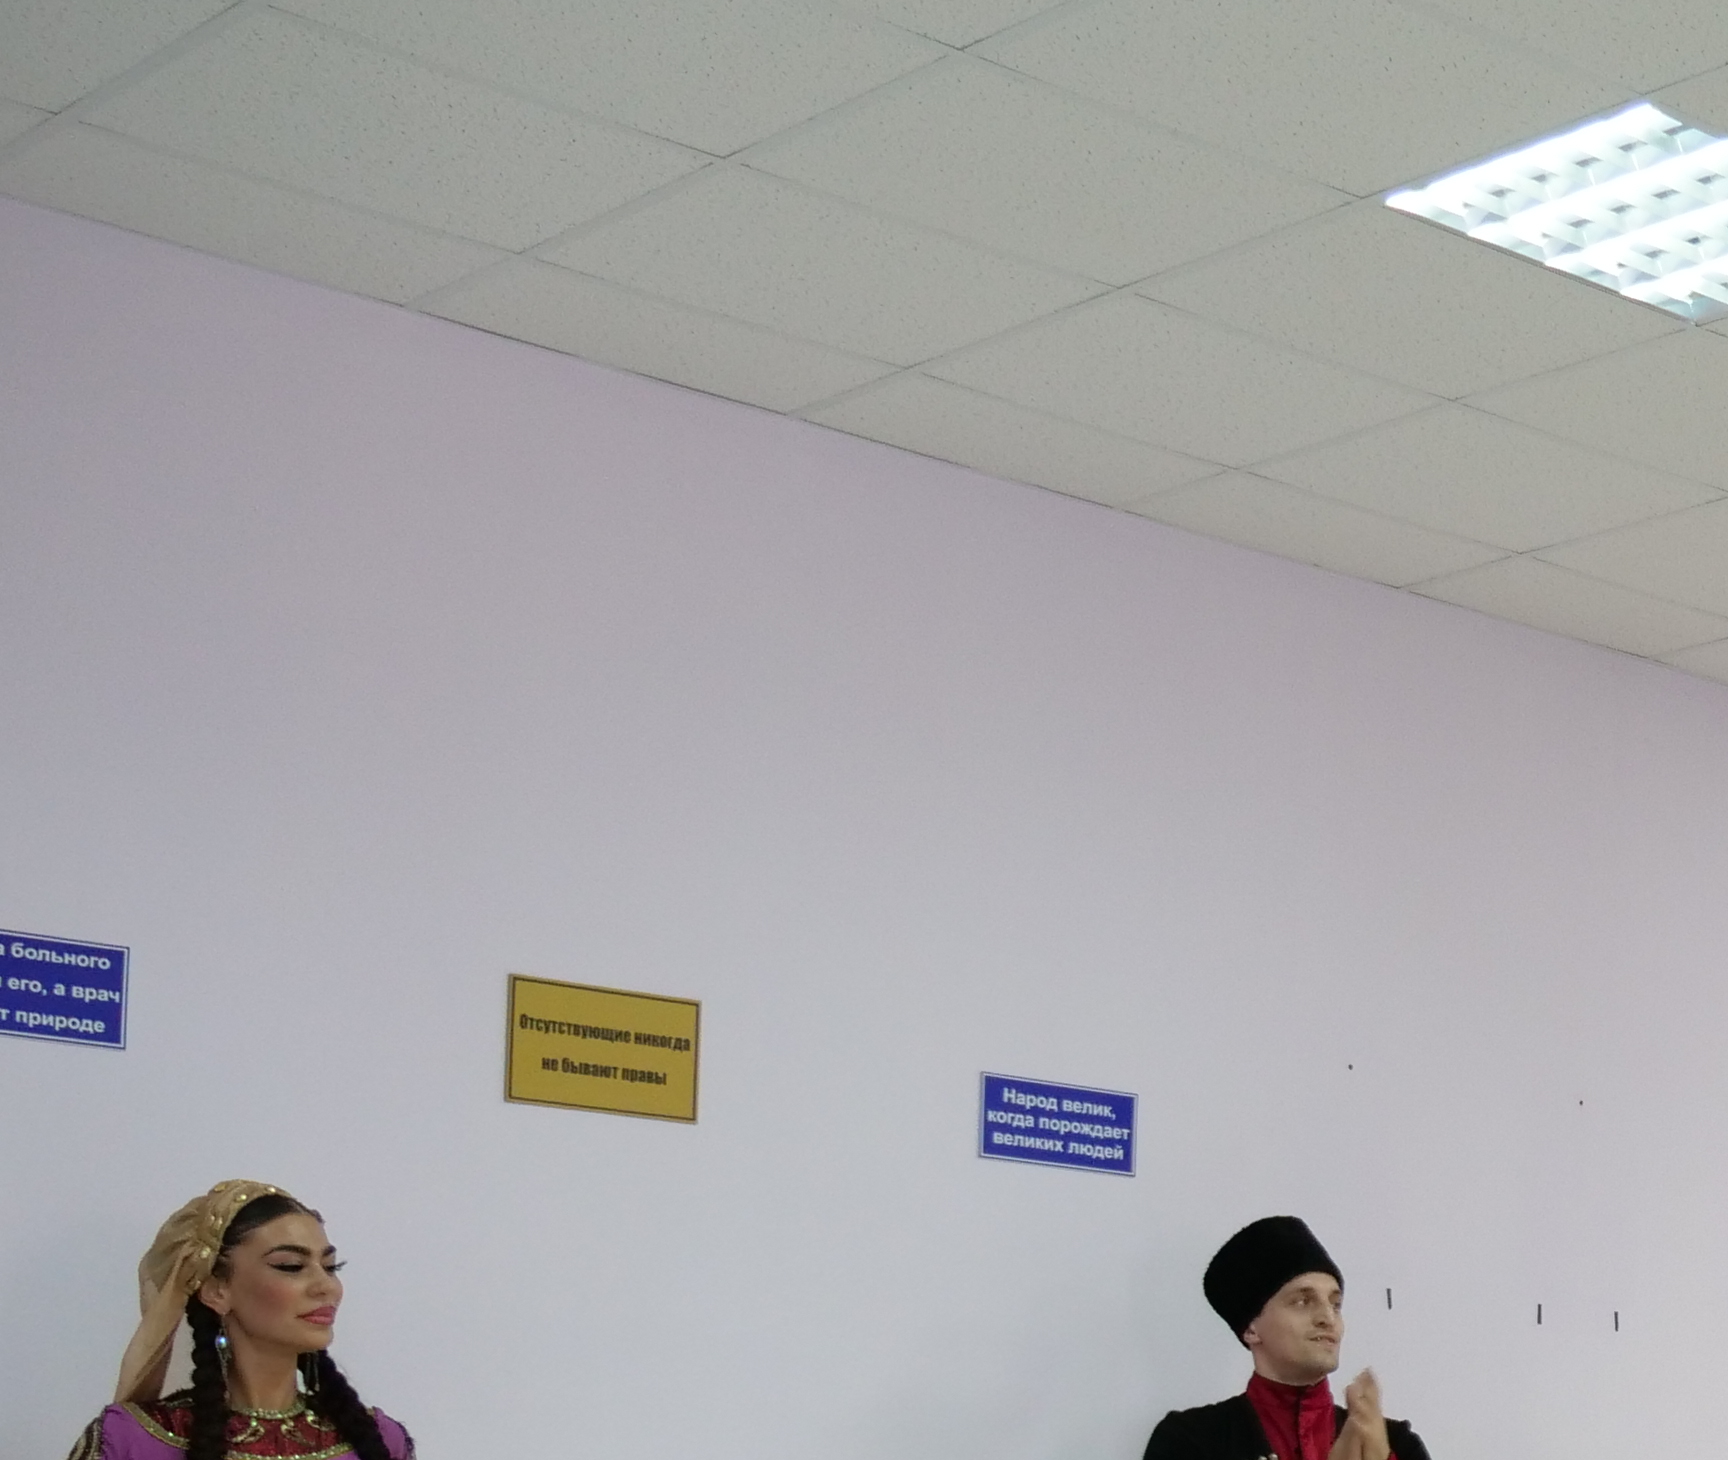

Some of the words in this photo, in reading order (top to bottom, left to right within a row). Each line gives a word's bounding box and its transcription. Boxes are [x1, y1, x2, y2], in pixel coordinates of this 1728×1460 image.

[11, 942, 111, 969] больного
[7, 977, 47, 996] его,
[53, 983, 66, 996] а
[71, 985, 120, 1003] врач
[15, 1010, 105, 1034] природе
[519, 1013, 631, 1043] Отсутствующие
[634, 1032, 691, 1053] никогда
[541, 1057, 558, 1071] не
[562, 1057, 618, 1080] бывают
[621, 1067, 667, 1085] правы
[1002, 1087, 1058, 1111] Народ
[1062, 1099, 1116, 1120] велик,
[987, 1110, 1034, 1129] когда
[1038, 1117, 1130, 1140] порождает
[992, 1131, 1064, 1152] великих
[1068, 1141, 1124, 1160] людей
